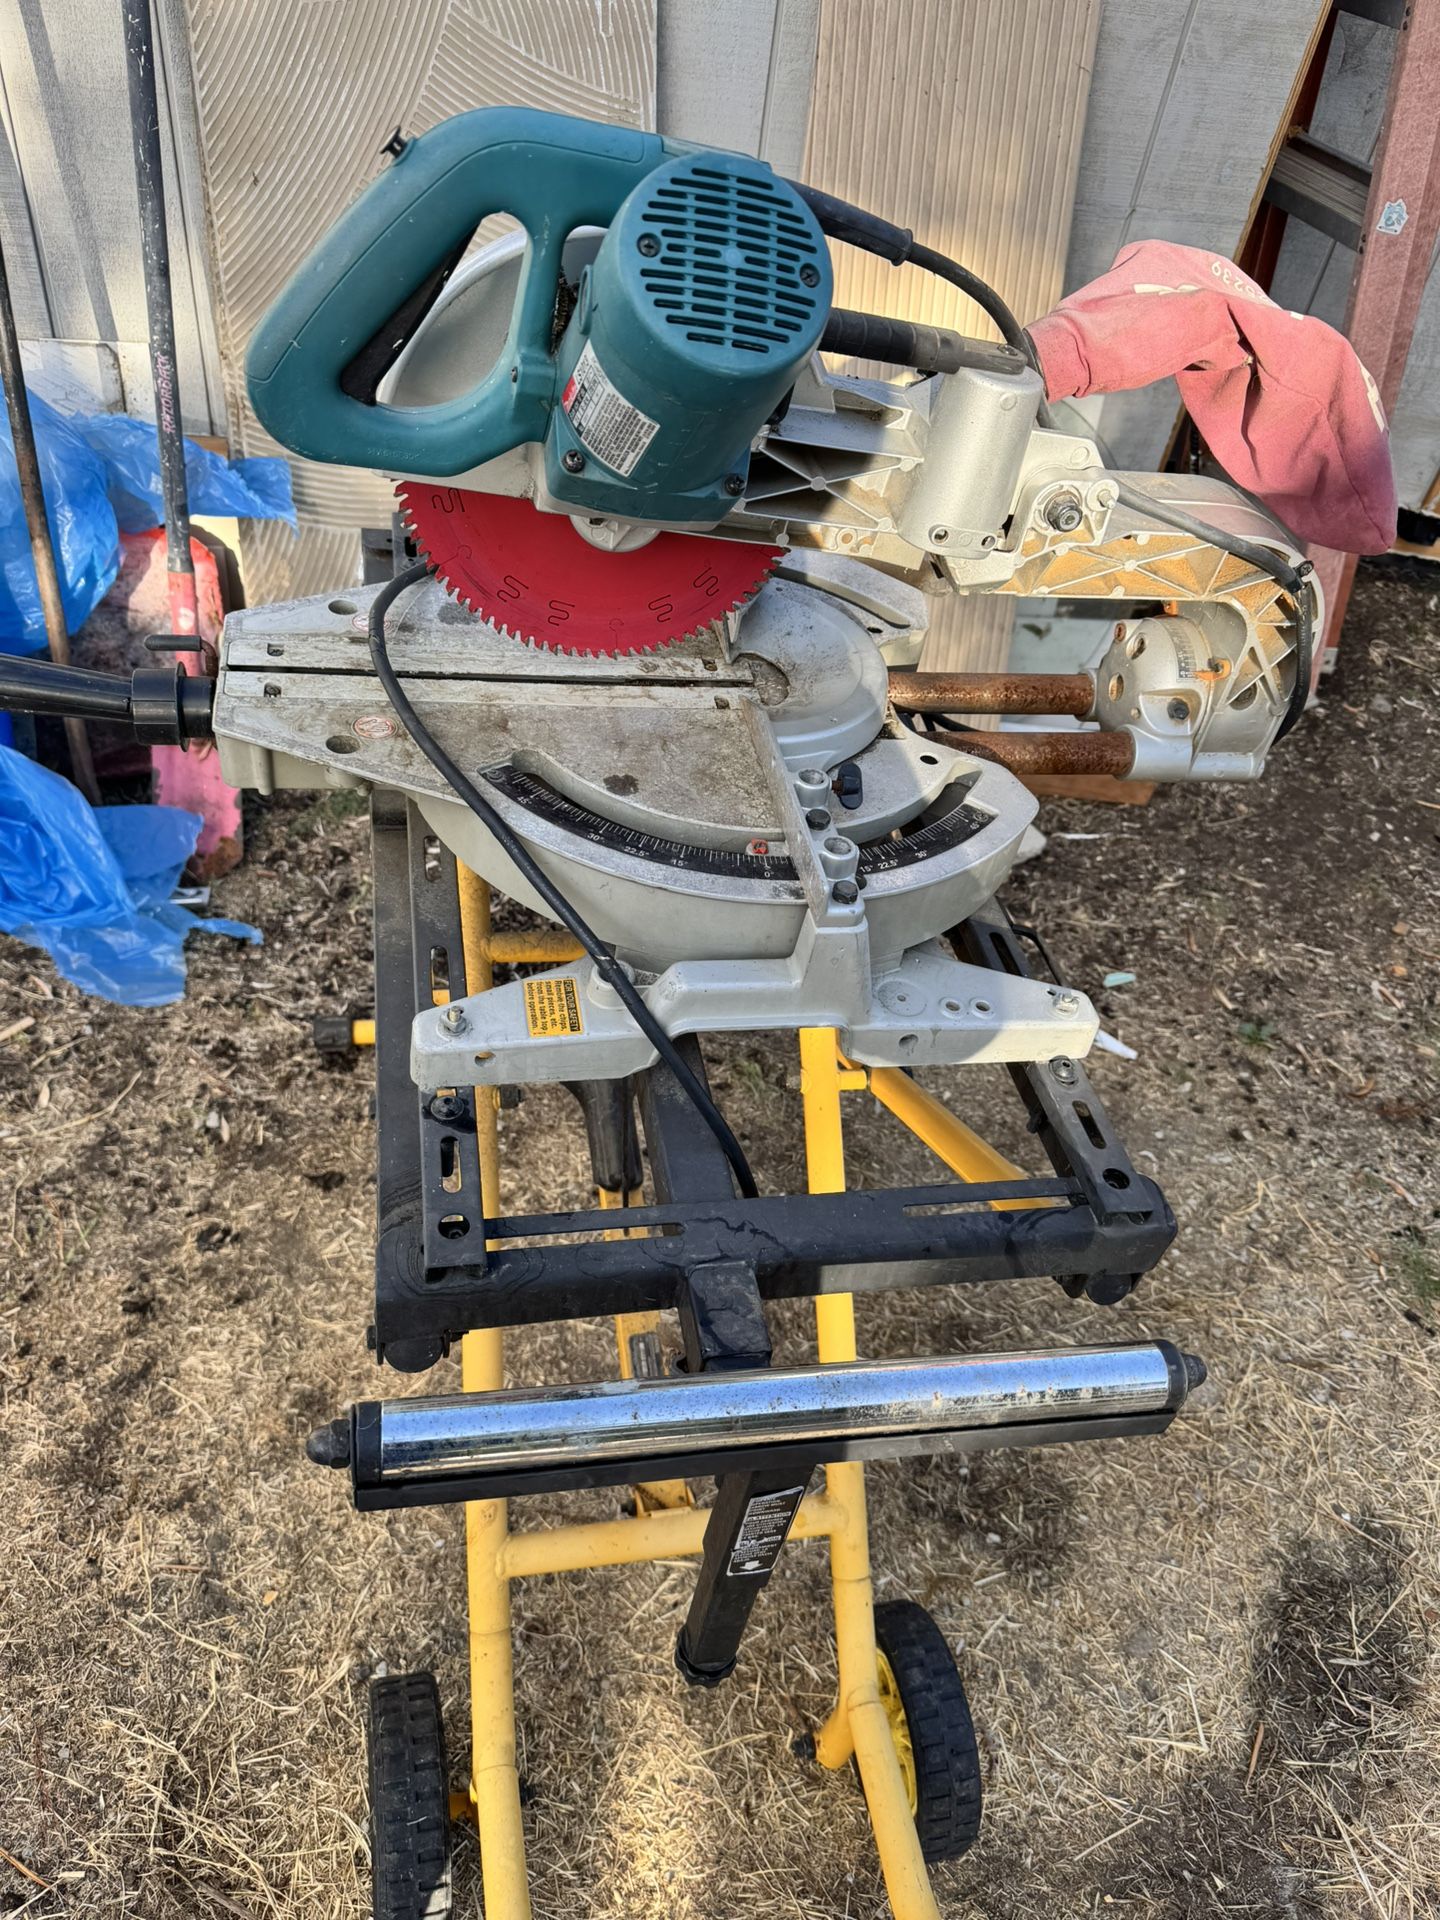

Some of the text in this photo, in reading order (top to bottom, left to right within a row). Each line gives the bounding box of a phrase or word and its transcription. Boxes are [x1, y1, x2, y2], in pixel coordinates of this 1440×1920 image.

[156, 351, 176, 434] RAZORBACK
[586, 832, 605, 842] 30°
[623, 845, 650, 857] 22.5°
[914, 849, 929, 859] 30°
[670, 858, 689, 867] 15°
[859, 864, 874, 873] 15°
[877, 858, 899, 870] 22.5°
[527, 982, 535, 1000] before
[554, 980, 563, 1002] Remove
[564, 981, 579, 1031] FOR YOUR SAFETY
